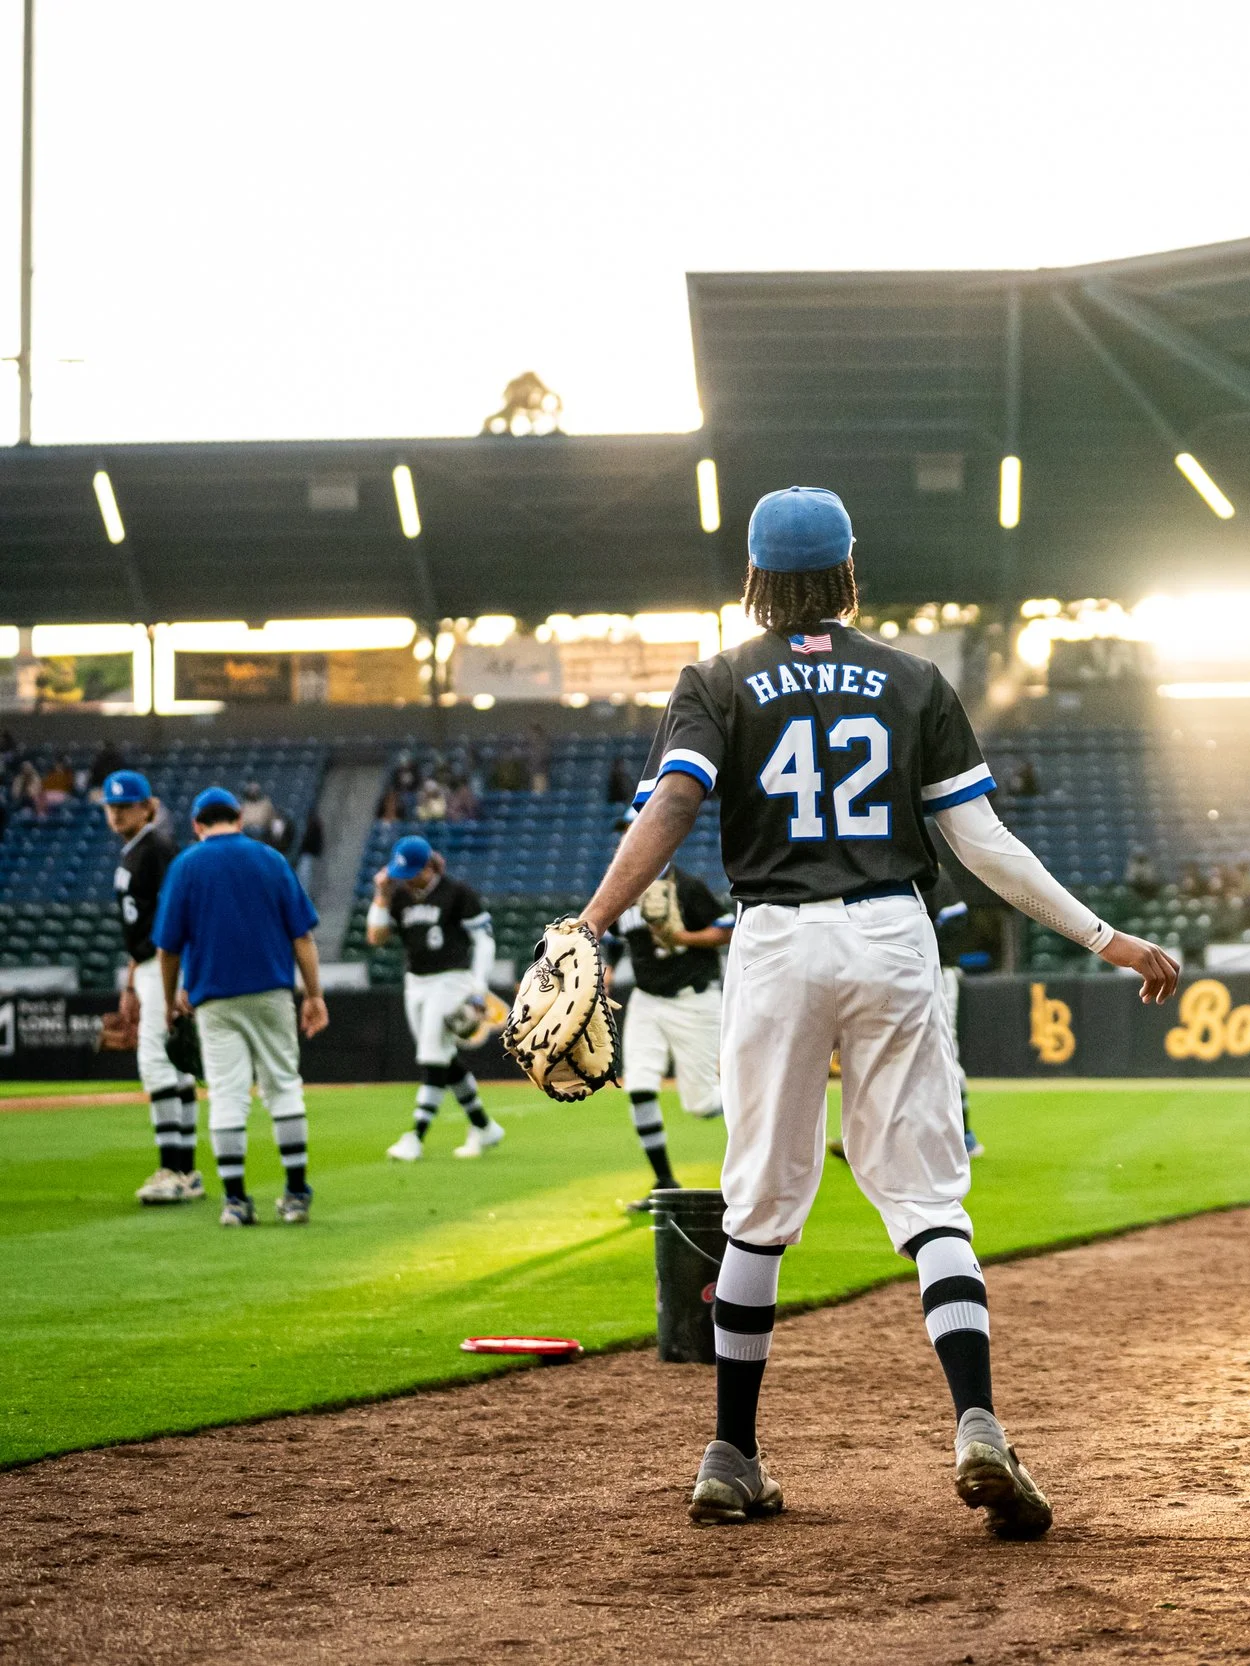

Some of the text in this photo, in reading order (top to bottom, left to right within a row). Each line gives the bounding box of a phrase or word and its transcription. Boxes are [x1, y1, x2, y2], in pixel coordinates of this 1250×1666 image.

[743, 661, 889, 708] HAYNES
[757, 714, 893, 842] 42
[1028, 983, 1077, 1064] LB
